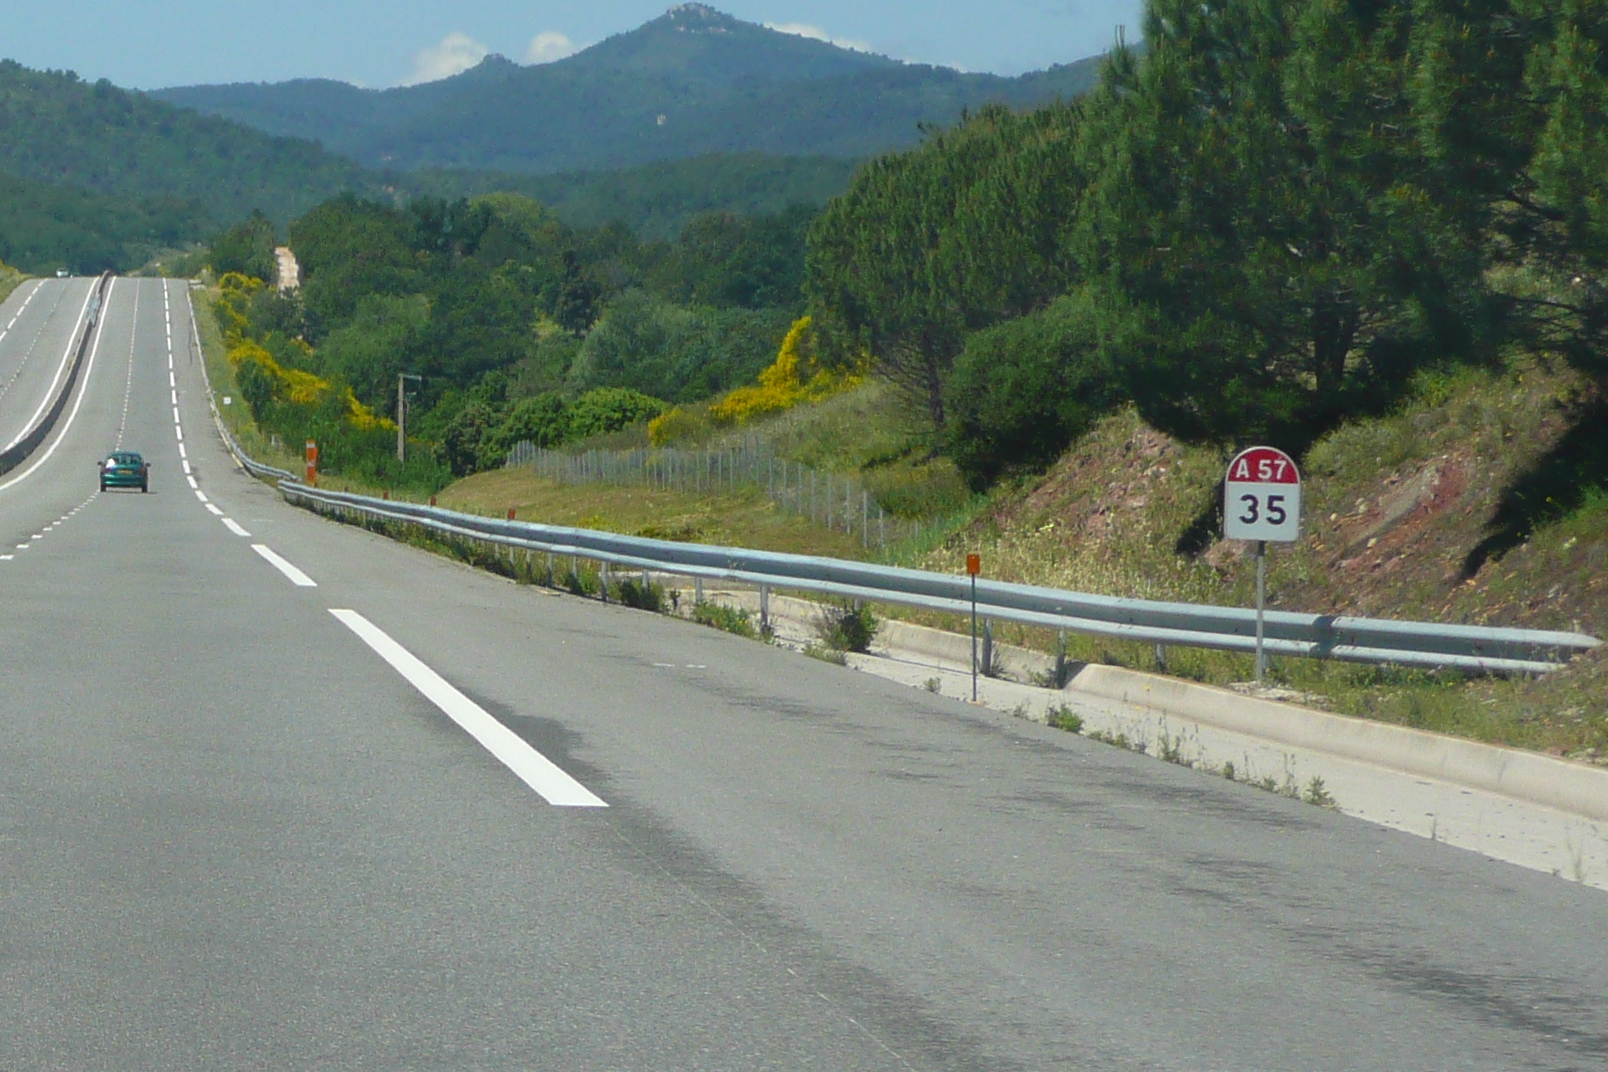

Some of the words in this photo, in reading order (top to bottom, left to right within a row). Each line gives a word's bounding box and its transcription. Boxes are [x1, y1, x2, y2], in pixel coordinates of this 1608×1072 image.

[1235, 458, 1250, 479] A
[1258, 459, 1287, 480] 57
[1239, 494, 1287, 525] 35
